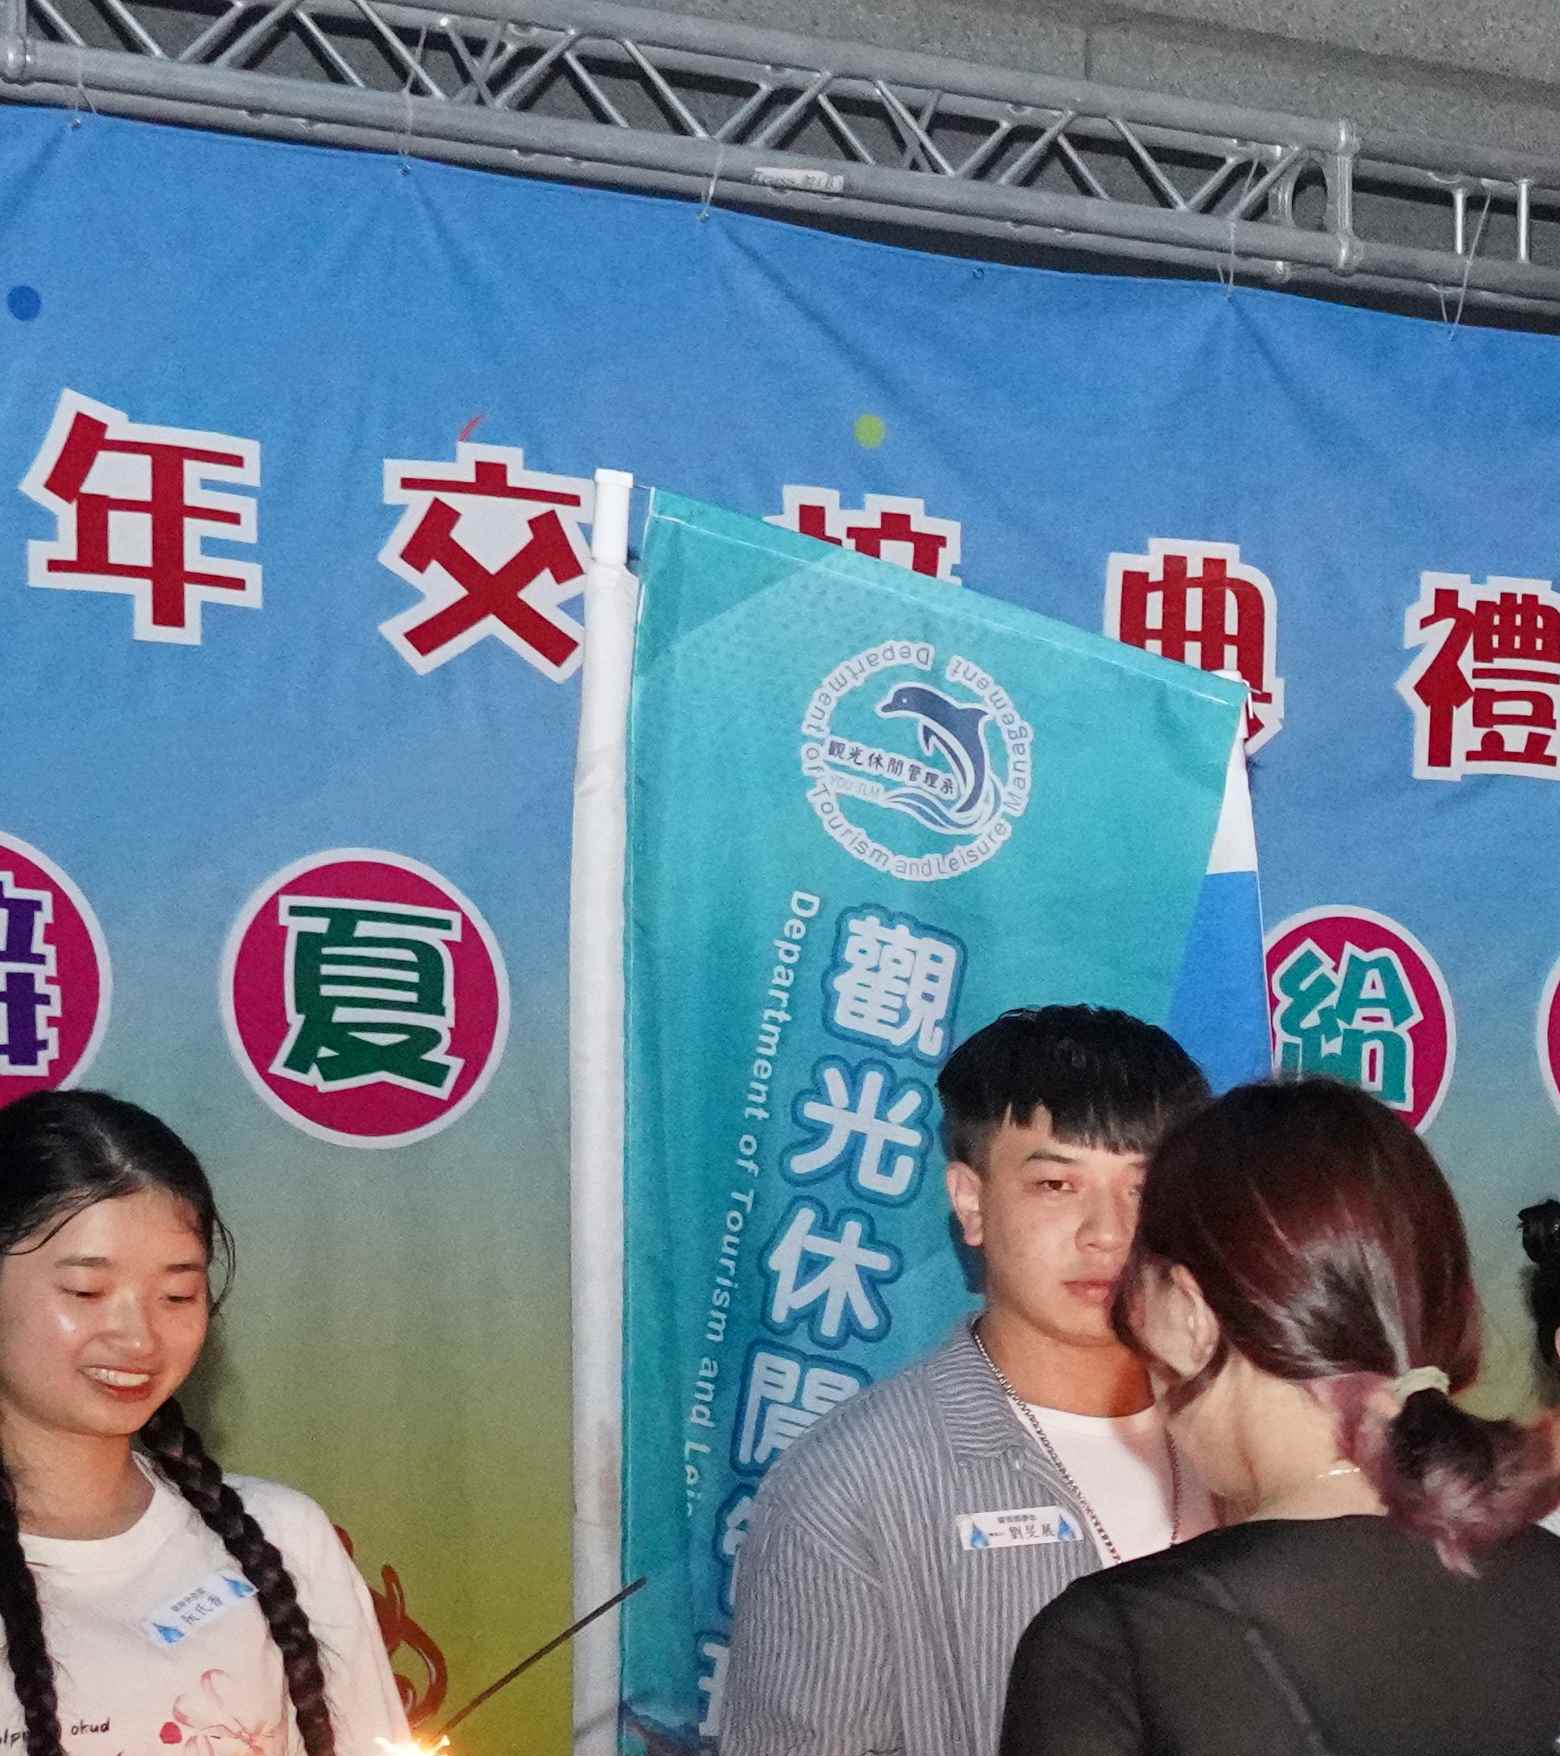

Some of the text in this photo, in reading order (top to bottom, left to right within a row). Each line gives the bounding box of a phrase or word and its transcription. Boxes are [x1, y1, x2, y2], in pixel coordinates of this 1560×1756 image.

[805, 644, 1030, 877] Department of Tourism and Leisure Management
[744, 890, 820, 1122] Department
[737, 1132, 761, 1178] of
[705, 1188, 756, 1343] Tourism
[690, 1357, 720, 1427] and
